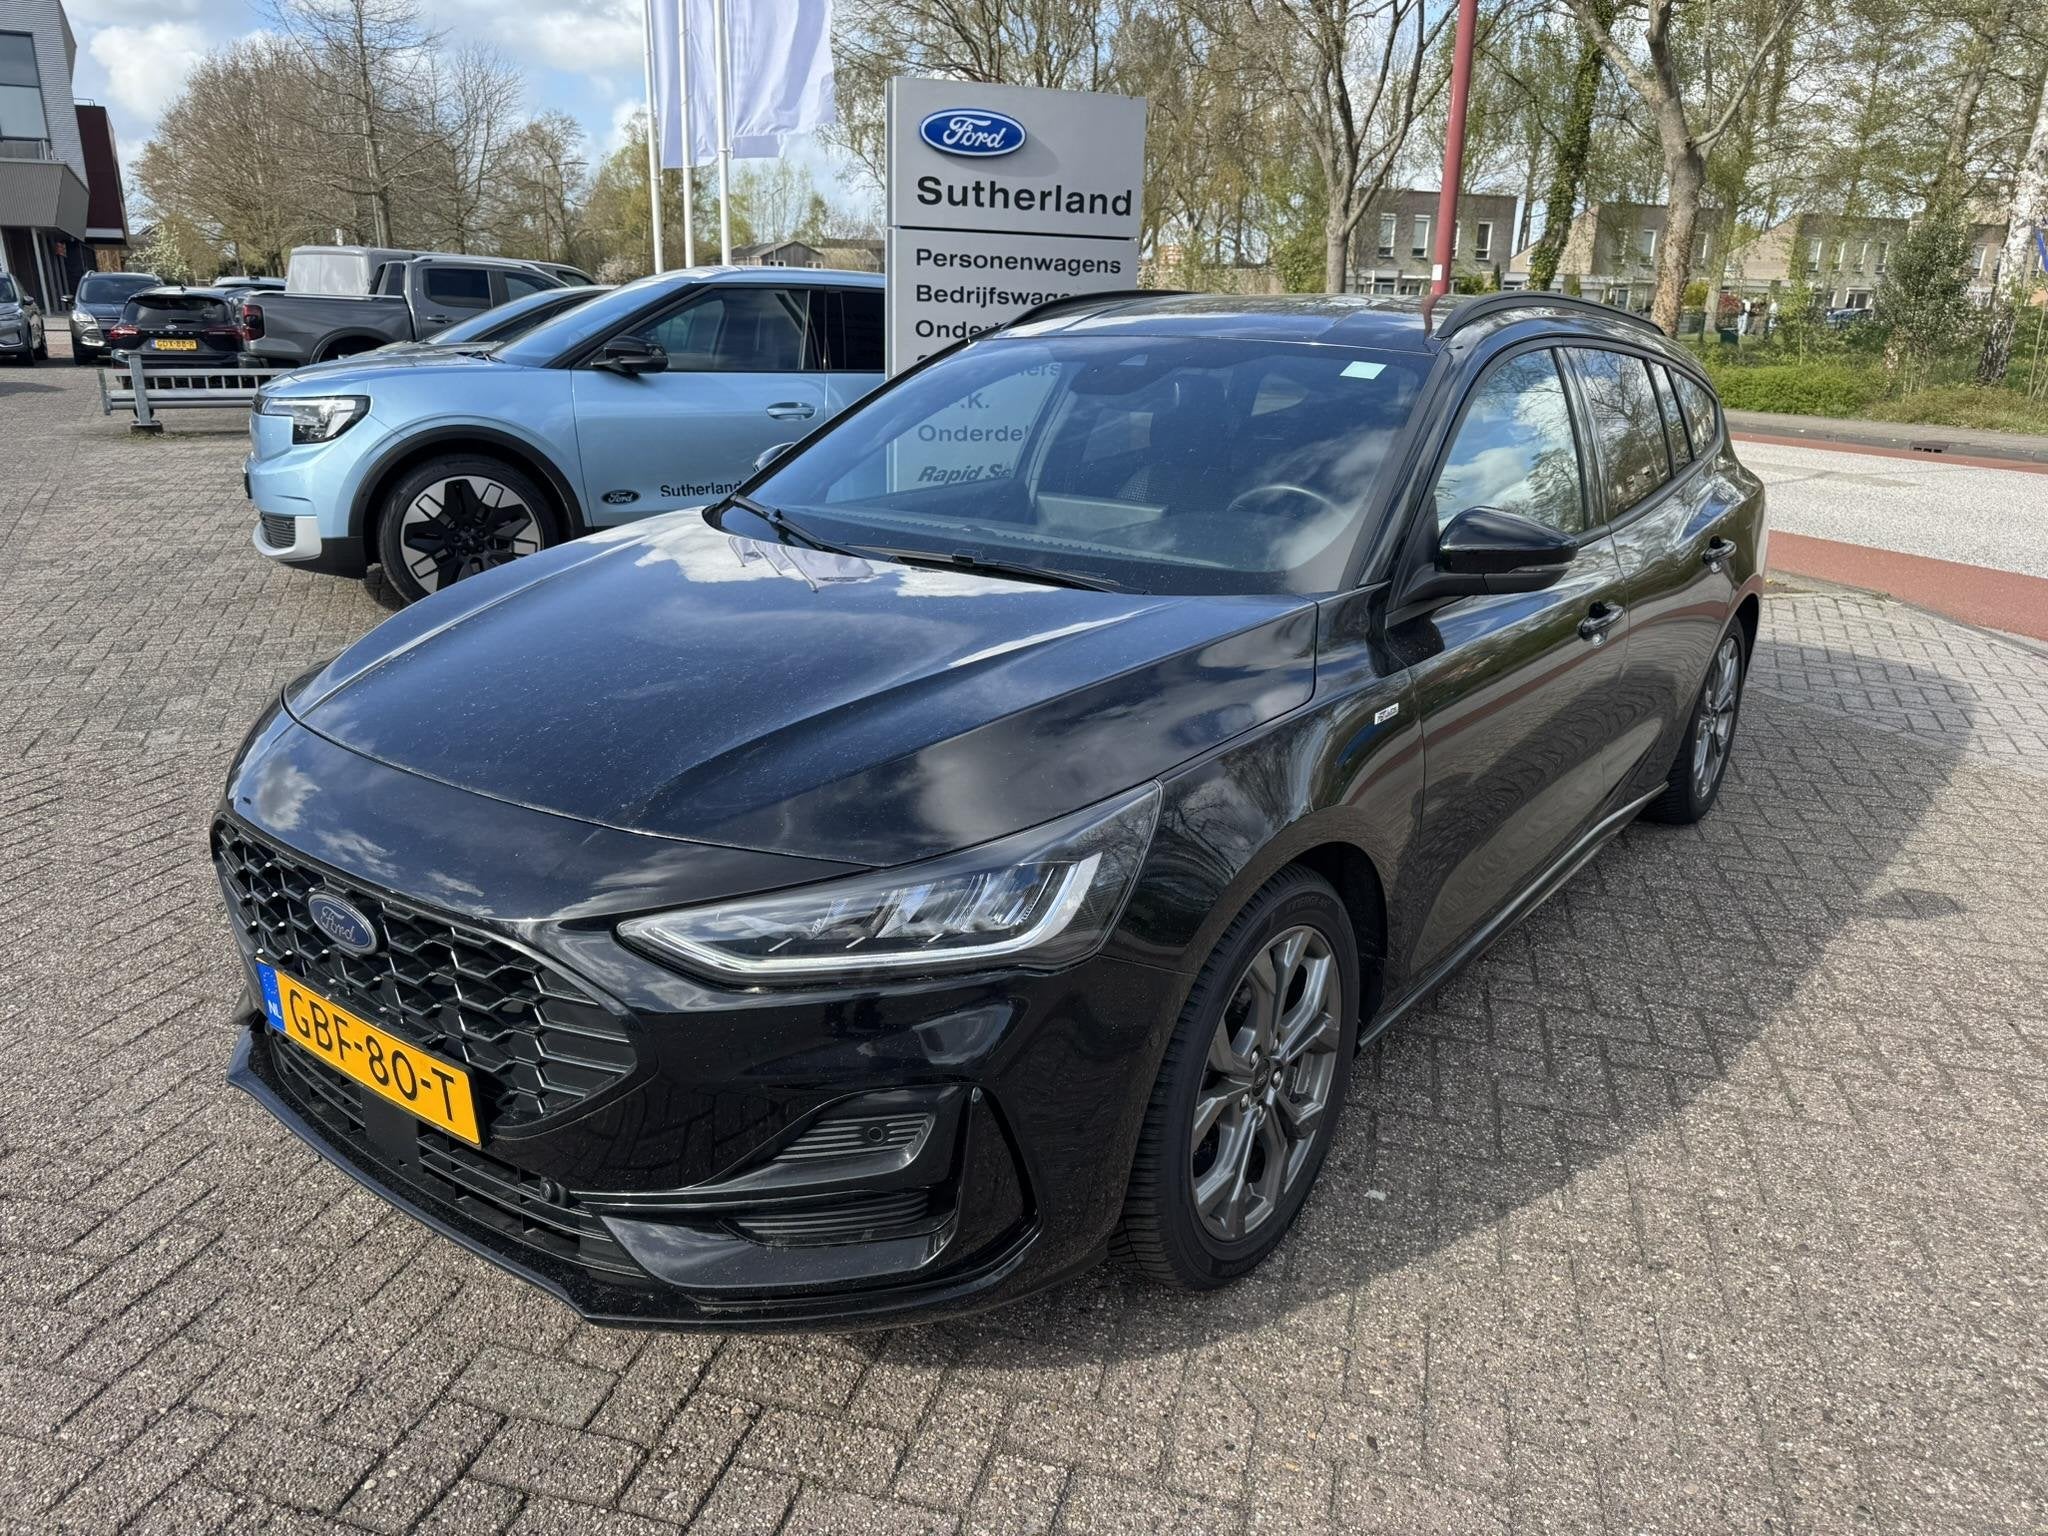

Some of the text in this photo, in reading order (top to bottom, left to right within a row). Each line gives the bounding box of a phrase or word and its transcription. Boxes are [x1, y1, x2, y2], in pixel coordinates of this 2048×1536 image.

[942, 116, 1006, 149] Ford
[916, 176, 1132, 216] Sutherland
[916, 248, 1122, 276] Personenwagens
[917, 464, 984, 484] Rapid
[608, 492, 634, 503] Ford
[320, 906, 356, 943] Ford
[268, 988, 456, 1122] NL GBF-80-T
